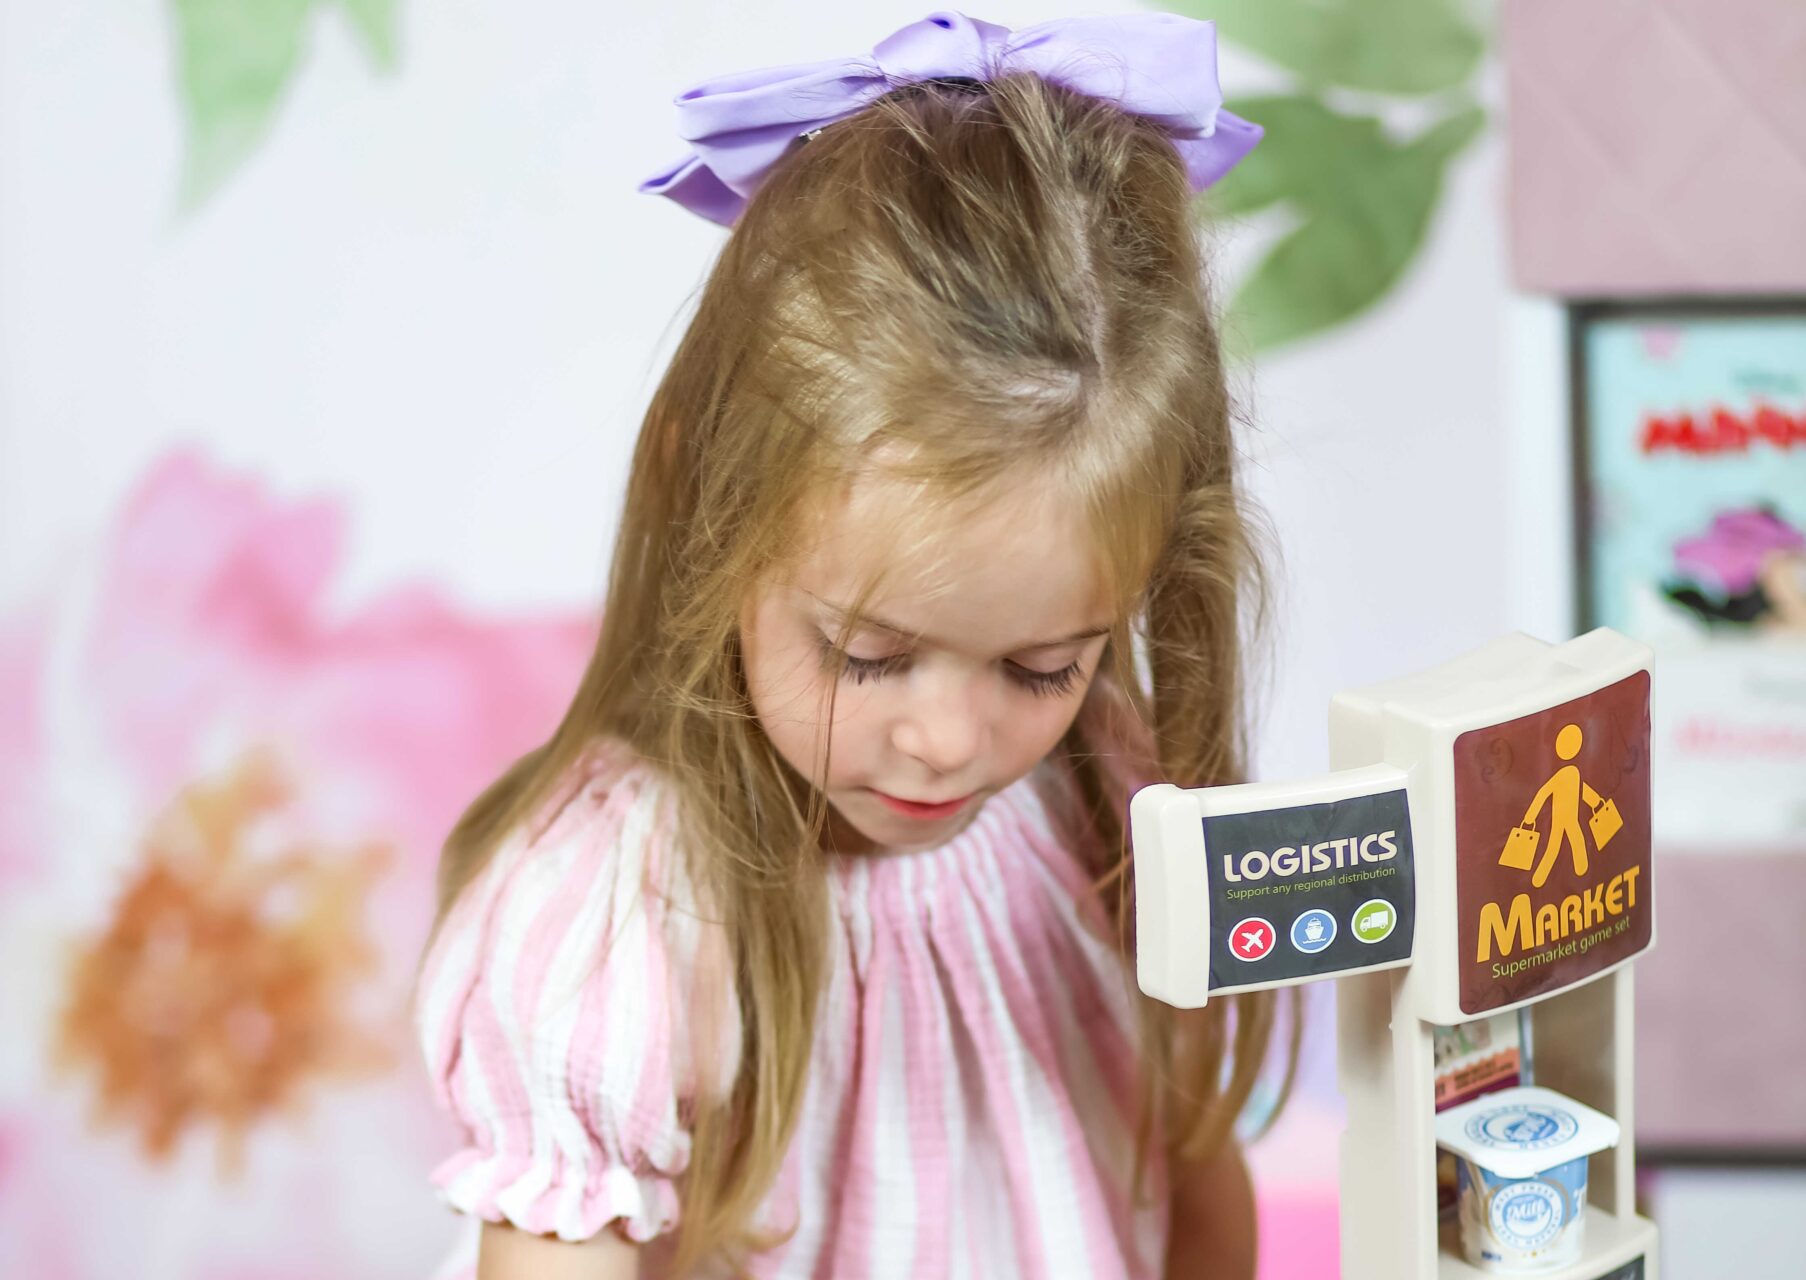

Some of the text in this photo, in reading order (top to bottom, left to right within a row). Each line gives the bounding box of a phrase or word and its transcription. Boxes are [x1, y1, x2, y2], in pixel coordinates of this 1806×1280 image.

[1224, 830, 1398, 882] LOGISTICS
[1226, 866, 1396, 901] Support any regional distribution
[1476, 865, 1640, 963] MARKET
[1492, 915, 1631, 979] Supermarket game set
